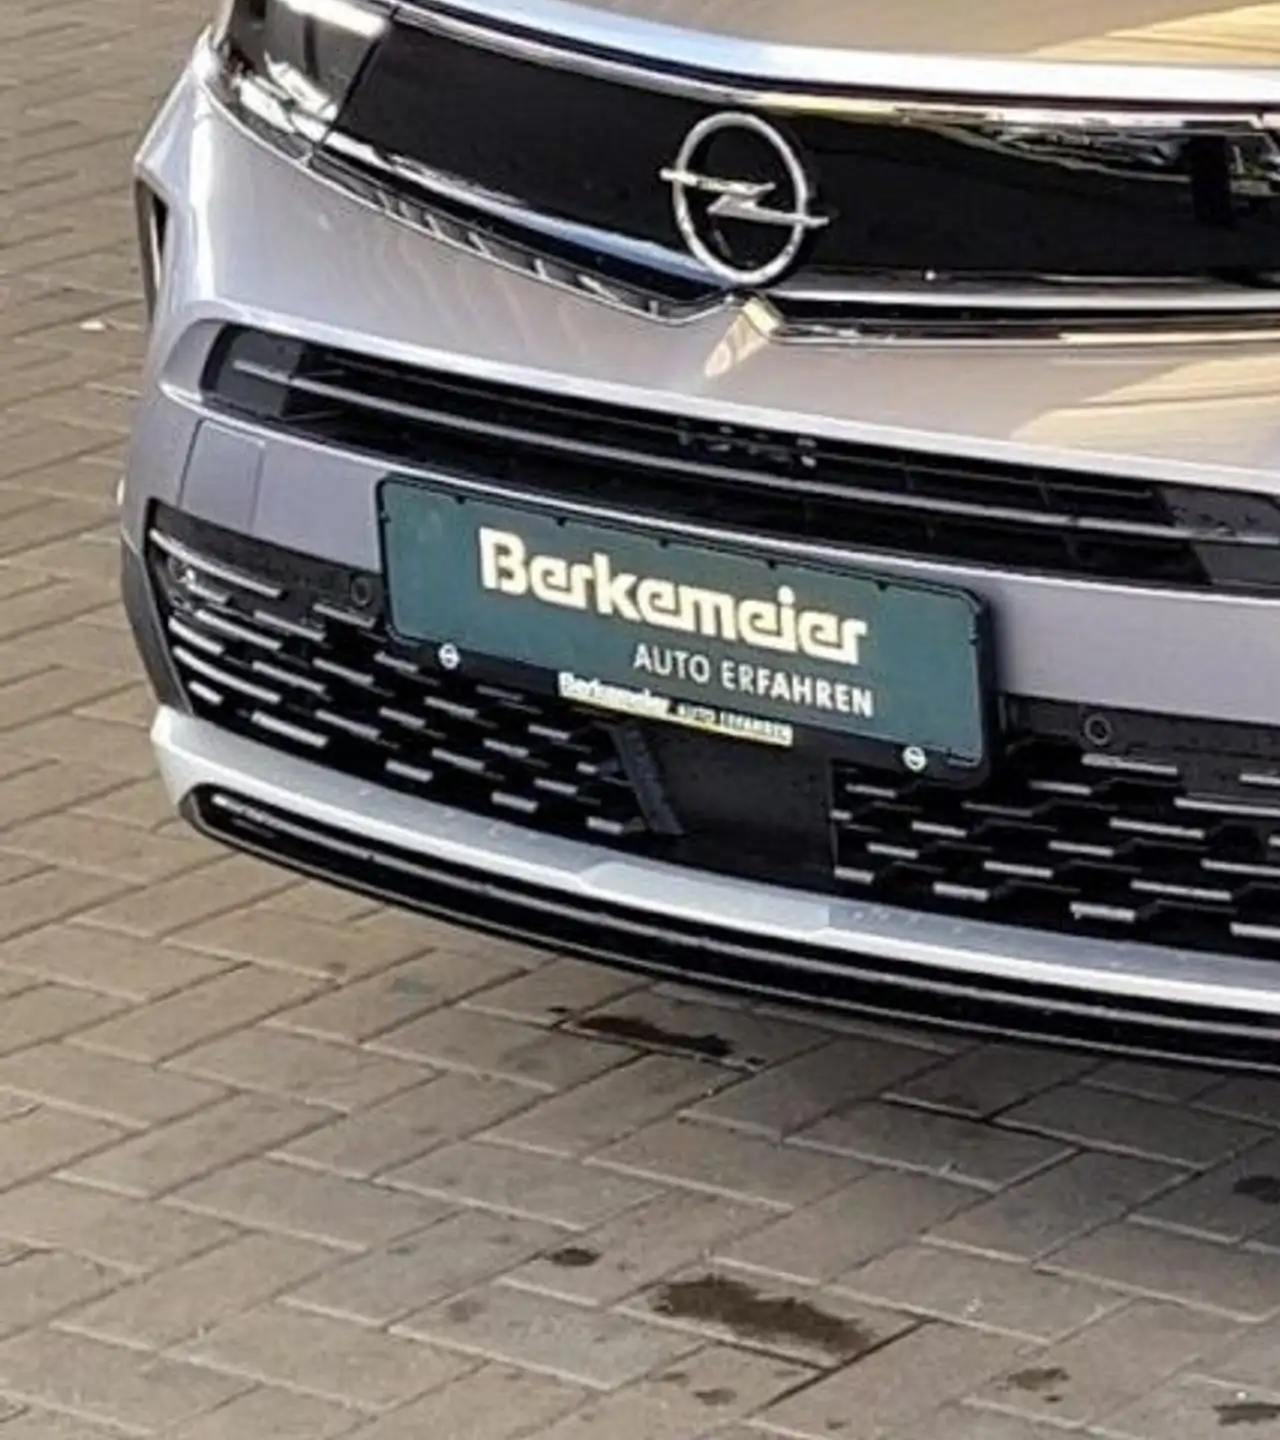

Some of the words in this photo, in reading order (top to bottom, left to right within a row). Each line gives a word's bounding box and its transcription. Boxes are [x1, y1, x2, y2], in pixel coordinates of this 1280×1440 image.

[480, 527, 867, 664] Berkemeier
[634, 644, 710, 685] AUTO
[721, 662, 874, 717] ERFAHREN
